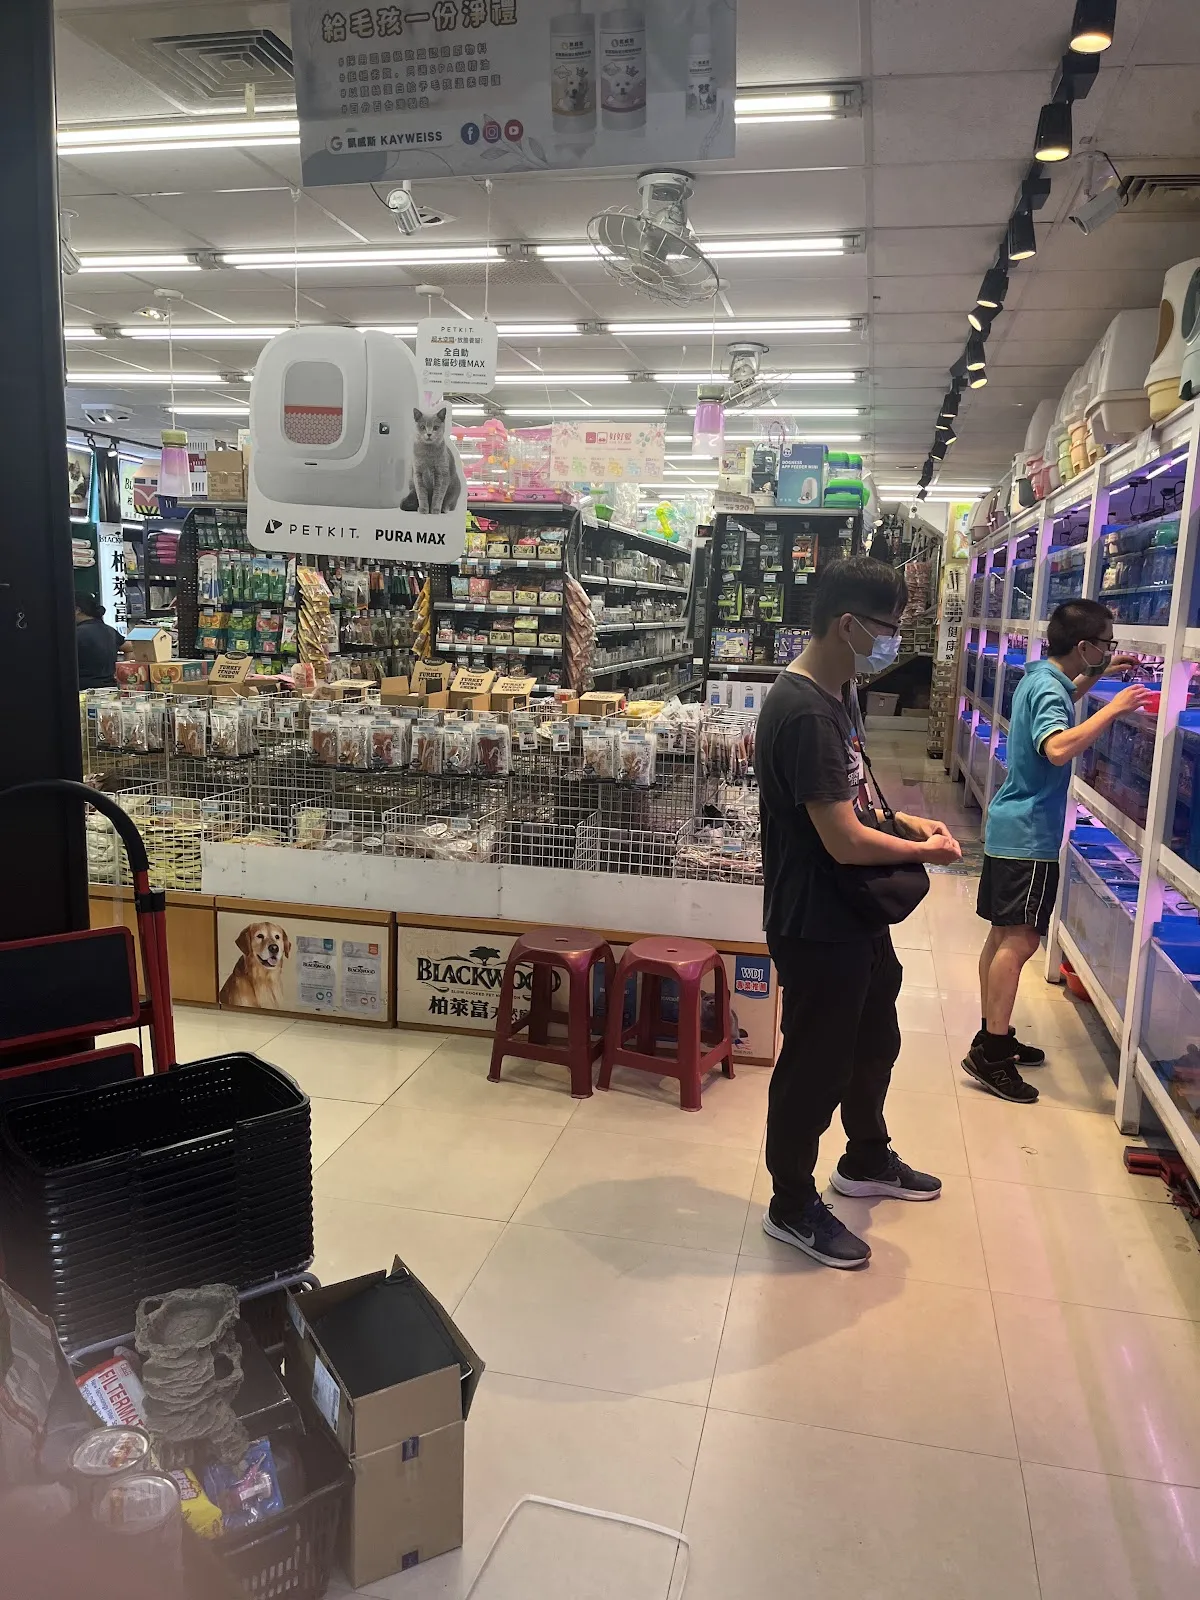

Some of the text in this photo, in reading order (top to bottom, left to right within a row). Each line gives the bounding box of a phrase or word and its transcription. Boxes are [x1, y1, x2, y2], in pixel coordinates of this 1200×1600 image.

[380, 131, 443, 146] KAYWEISS
[444, 347, 469, 357] 全自動
[375, 528, 413, 543] PURA
[416, 531, 446, 545] MAX
[741, 967, 764, 981] WDJ
